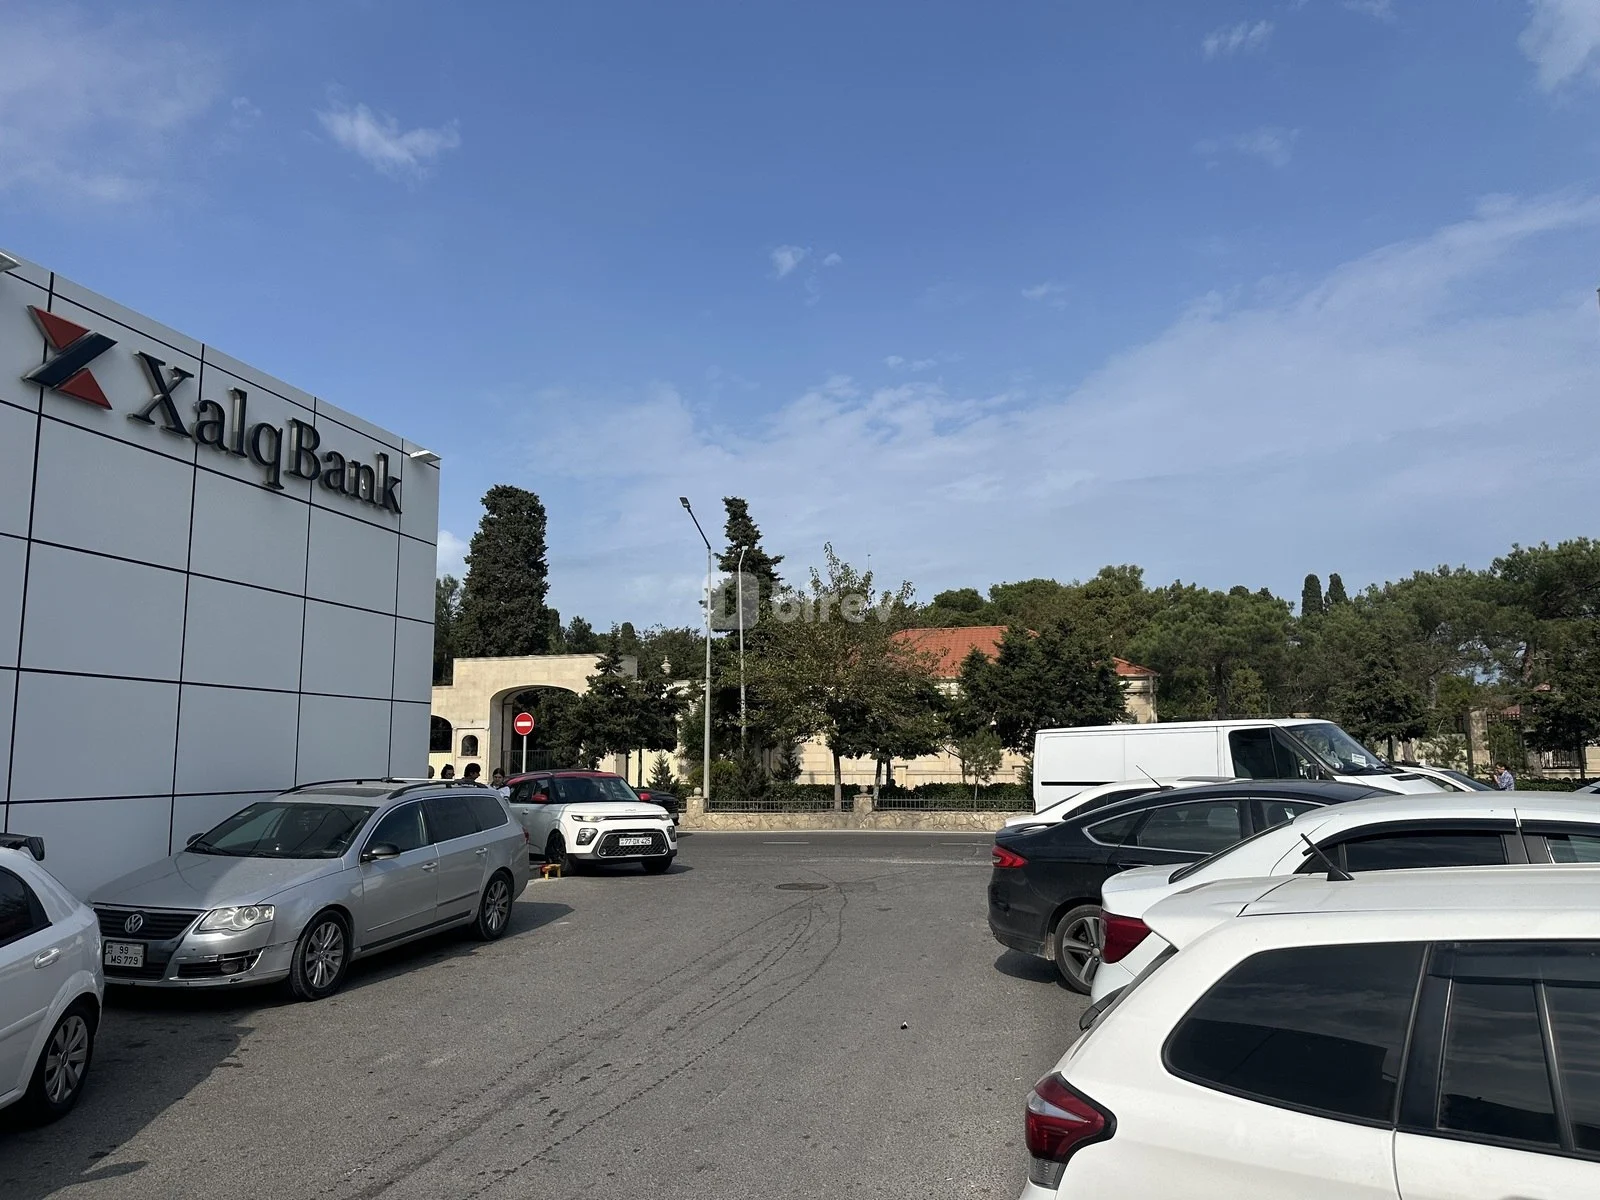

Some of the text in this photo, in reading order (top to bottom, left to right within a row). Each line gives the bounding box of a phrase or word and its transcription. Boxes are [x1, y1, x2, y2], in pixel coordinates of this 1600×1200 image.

[127, 351, 402, 515] XalqBank
[119, 945, 129, 955] 99
[110, 955, 139, 965] MS 779
